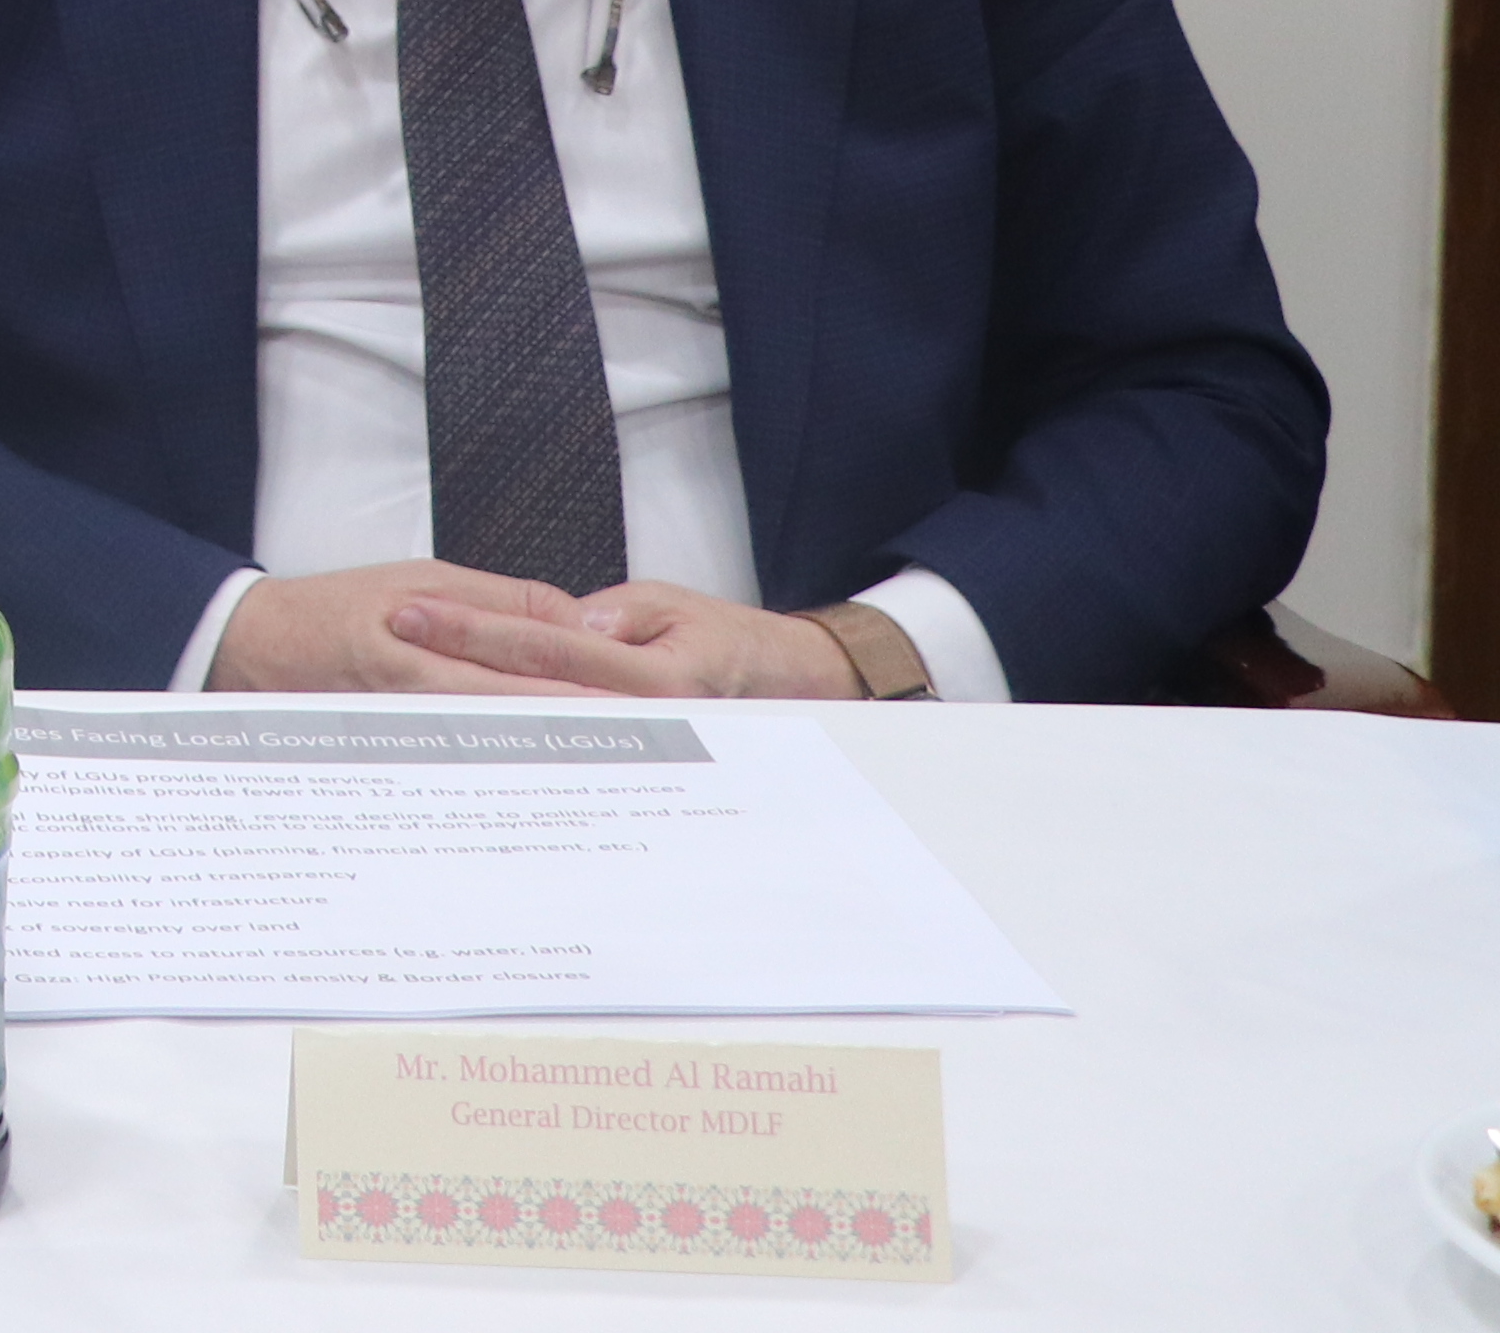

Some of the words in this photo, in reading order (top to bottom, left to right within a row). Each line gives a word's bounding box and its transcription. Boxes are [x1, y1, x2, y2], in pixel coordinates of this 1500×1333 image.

[71, 728, 166, 748] Facing
[174, 732, 250, 747] Local
[259, 733, 450, 748] Government
[456, 734, 536, 748] Units
[545, 734, 644, 751] (LGUs)
[47, 770, 67, 780] of
[74, 771, 129, 782] LGUs
[136, 773, 217, 784] provide
[224, 774, 300, 784] limited
[19, 784, 146, 796] unicipalities
[153, 787, 235, 798] provide
[241, 787, 302, 797] fewer
[312, 787, 361, 797] than
[370, 788, 395, 797] 12
[402, 787, 423, 797] of
[430, 787, 466, 797] the
[474, 786, 590, 799] prescribed
[597, 784, 686, 794] services
[36, 812, 125, 824] budgets
[254, 813, 343, 822] revenue
[355, 812, 434, 821] decline
[445, 810, 486, 820] due
[496, 810, 520, 819] to
[532, 809, 618, 820] political
[630, 808, 670, 817] and
[682, 807, 748, 817] socio-
[36, 823, 152, 833] conditions
[181, 821, 275, 832] addition
[281, 821, 306, 831] to
[313, 821, 394, 831] culture
[399, 820, 420, 830] of
[22, 848, 112, 859] capacity
[121, 848, 143, 858] of
[149, 848, 206, 857] LGUs
[332, 845, 427, 856] financial
[8, 873, 152, 884] ccountability
[161, 873, 202, 882] and
[208, 871, 357, 881] transparency
[7, 899, 59, 908] nsive
[67, 898, 124, 908] need
[131, 898, 163, 908] for
[170, 896, 328, 908] infrastructure
[21, 923, 43, 932] of
[51, 923, 183, 934] sovereignty
[192, 923, 242, 932] over
[250, 922, 300, 932] land
[69, 949, 143, 958] access
[151, 949, 174, 958] to
[182, 948, 265, 958] natural
[273, 947, 387, 958] resources
[531, 944, 592, 955] land)
[86, 974, 140, 984] High
[148, 973, 275, 983] Population
[284, 973, 369, 984] density
[378, 973, 398, 983] &
[404, 972, 484, 983] Border
[492, 971, 590, 981] closures
[396, 1053, 447, 1080] Mr.
[460, 1055, 653, 1087] Mohammed
[666, 1061, 700, 1089] Al
[712, 1063, 838, 1093] Ramahi
[451, 1102, 561, 1128] General
[571, 1105, 691, 1132] Director
[702, 1111, 783, 1135] MDLF
